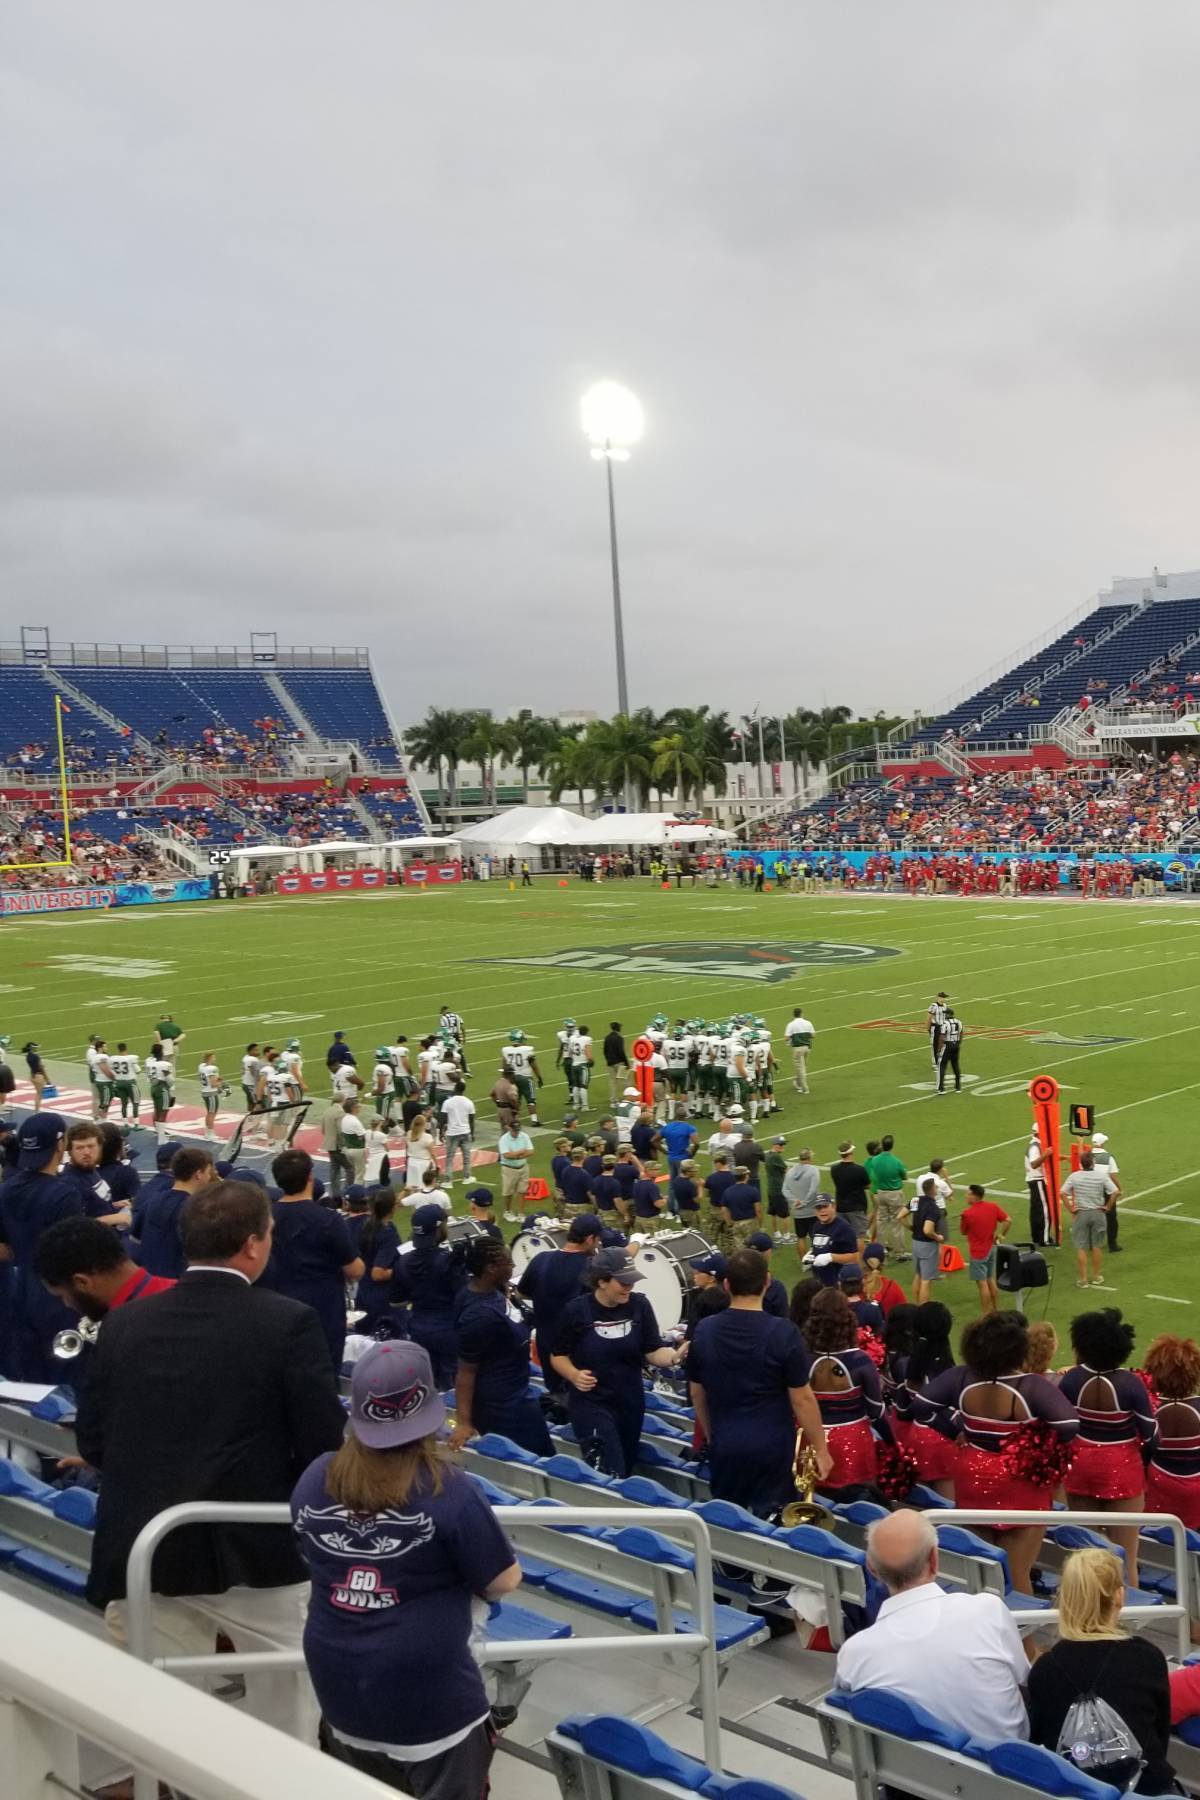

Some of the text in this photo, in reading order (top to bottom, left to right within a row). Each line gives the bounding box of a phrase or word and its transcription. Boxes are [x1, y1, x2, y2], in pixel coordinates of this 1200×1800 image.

[211, 850, 230, 864] 25
[669, 1046, 685, 1060] 35
[713, 1044, 727, 1059] 79
[507, 1053, 522, 1067] 70
[112, 1061, 129, 1075] 23
[1077, 1106, 1089, 1129] 1
[350, 1570, 377, 1592] GO
[336, 1588, 396, 1609] OWLS
